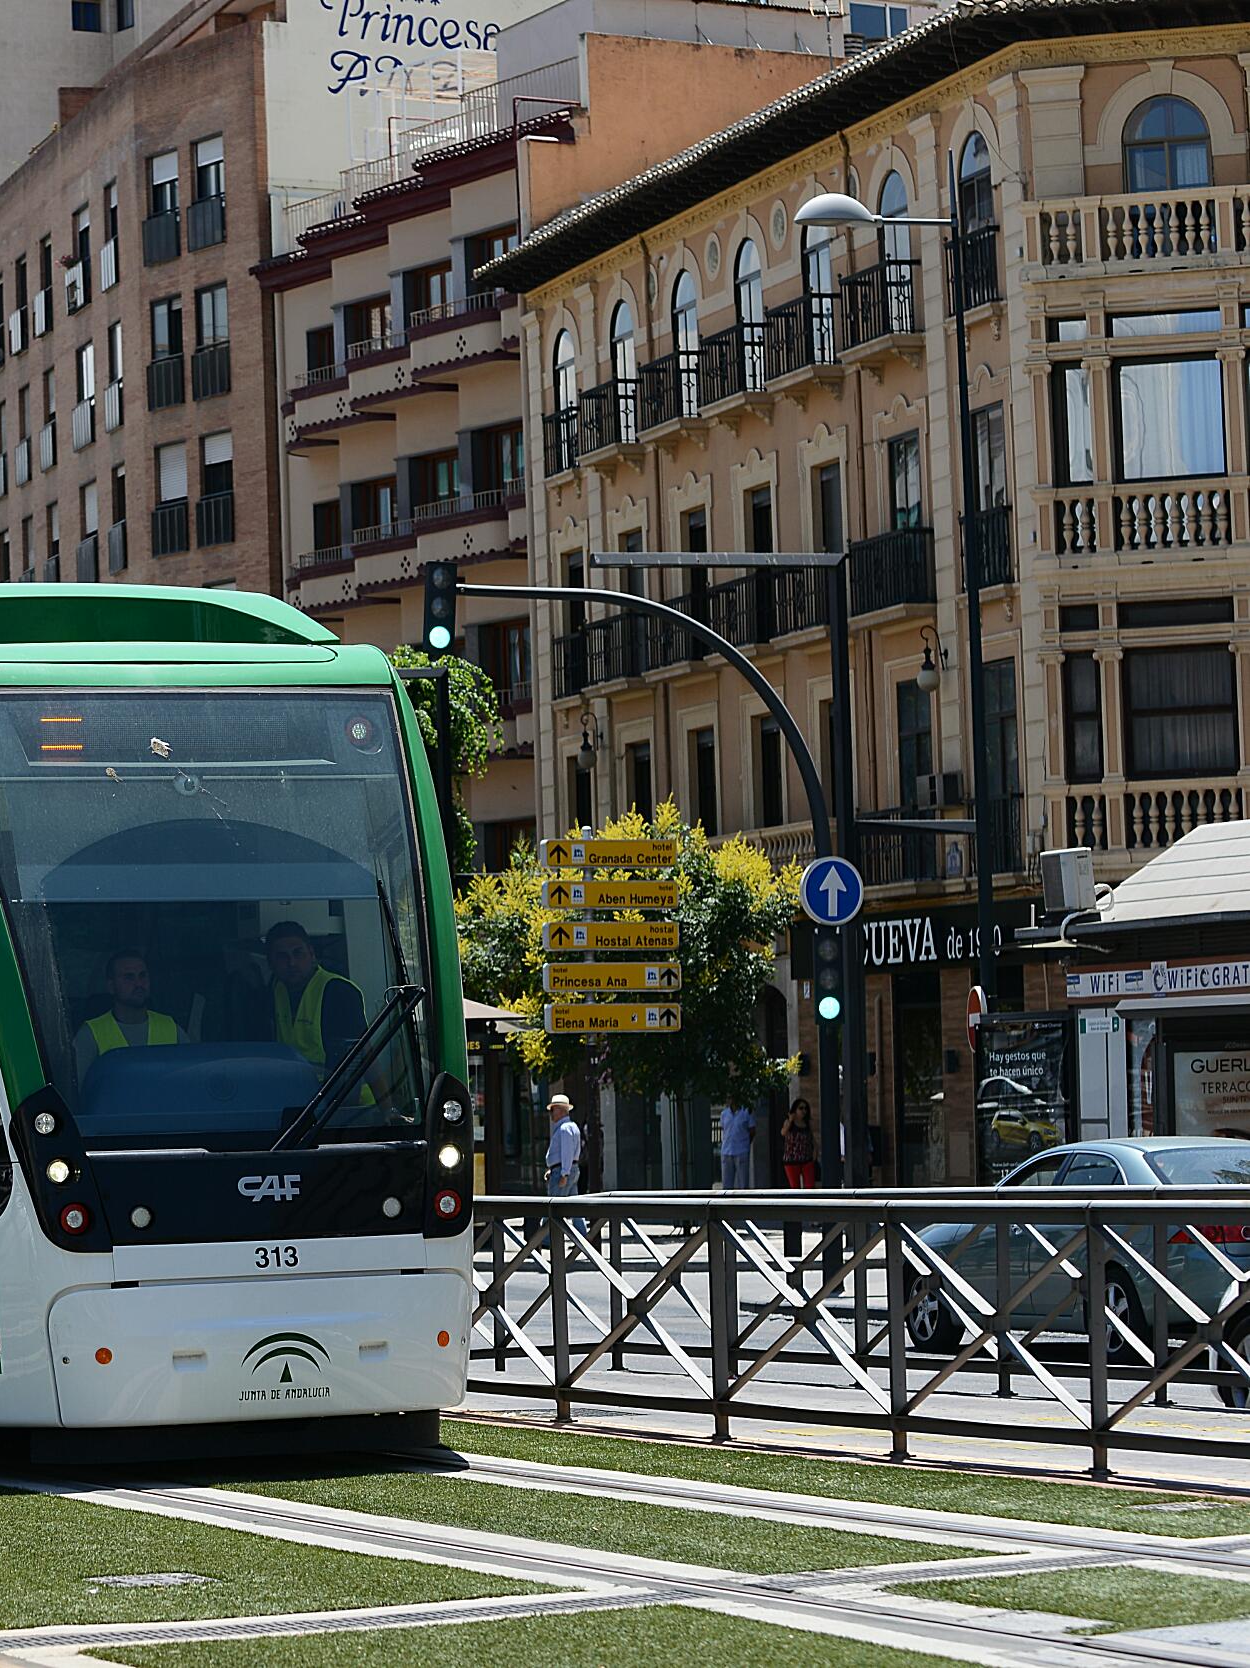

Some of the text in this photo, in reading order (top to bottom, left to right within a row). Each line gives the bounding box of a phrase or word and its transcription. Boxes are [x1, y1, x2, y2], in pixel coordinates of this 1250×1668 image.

[652, 842, 673, 851] hotel
[589, 853, 673, 864] Granada Center
[598, 893, 674, 906] Aben Humeya
[650, 926, 675, 934] hostal
[595, 935, 674, 947] Hostal Atenas
[946, 926, 963, 959] de
[553, 976, 628, 987] Princesa Ana
[555, 1017, 584, 1029] Elena
[989, 1051, 1047, 1064] Hay gestos que
[990, 1064, 1044, 1077] te hacen único
[237, 1174, 301, 1202] CAF
[254, 1245, 299, 1269] 313
[239, 1387, 330, 1401] JUNTA DE ANDALUCIA
